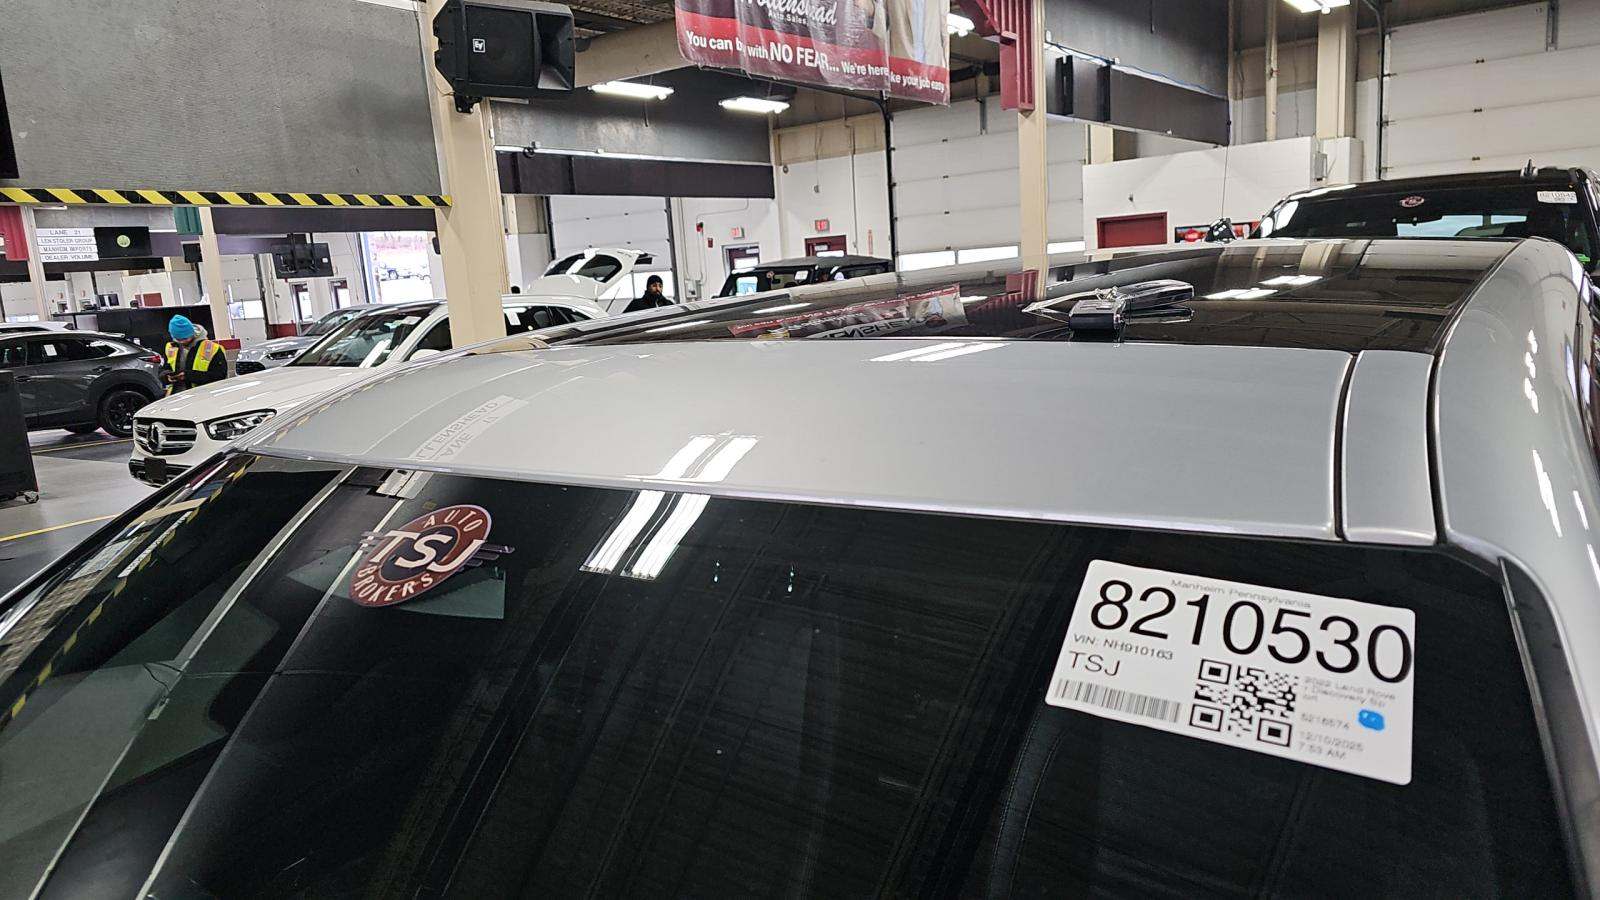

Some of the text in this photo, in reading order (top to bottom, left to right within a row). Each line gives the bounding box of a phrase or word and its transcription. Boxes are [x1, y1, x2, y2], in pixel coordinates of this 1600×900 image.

[686, 31, 707, 48] You
[709, 37, 733, 51] can
[747, 45, 769, 60] with
[769, 43, 793, 64] NO
[796, 49, 840, 73] FEAR...
[841, 61, 866, 75] We're
[868, 64, 889, 76] here
[890, 71, 901, 83] ke
[423, 509, 483, 532] AUTO
[369, 529, 485, 573] TSJ
[355, 565, 434, 602] BROKERS
[1171, 578, 1312, 609] Manheim Pennsylvania
[1073, 633, 1174, 661] VIN: NH910163
[1090, 579, 1414, 684] 8210530
[1069, 650, 1121, 677] TSJ
[1335, 680, 1364, 694] Land
